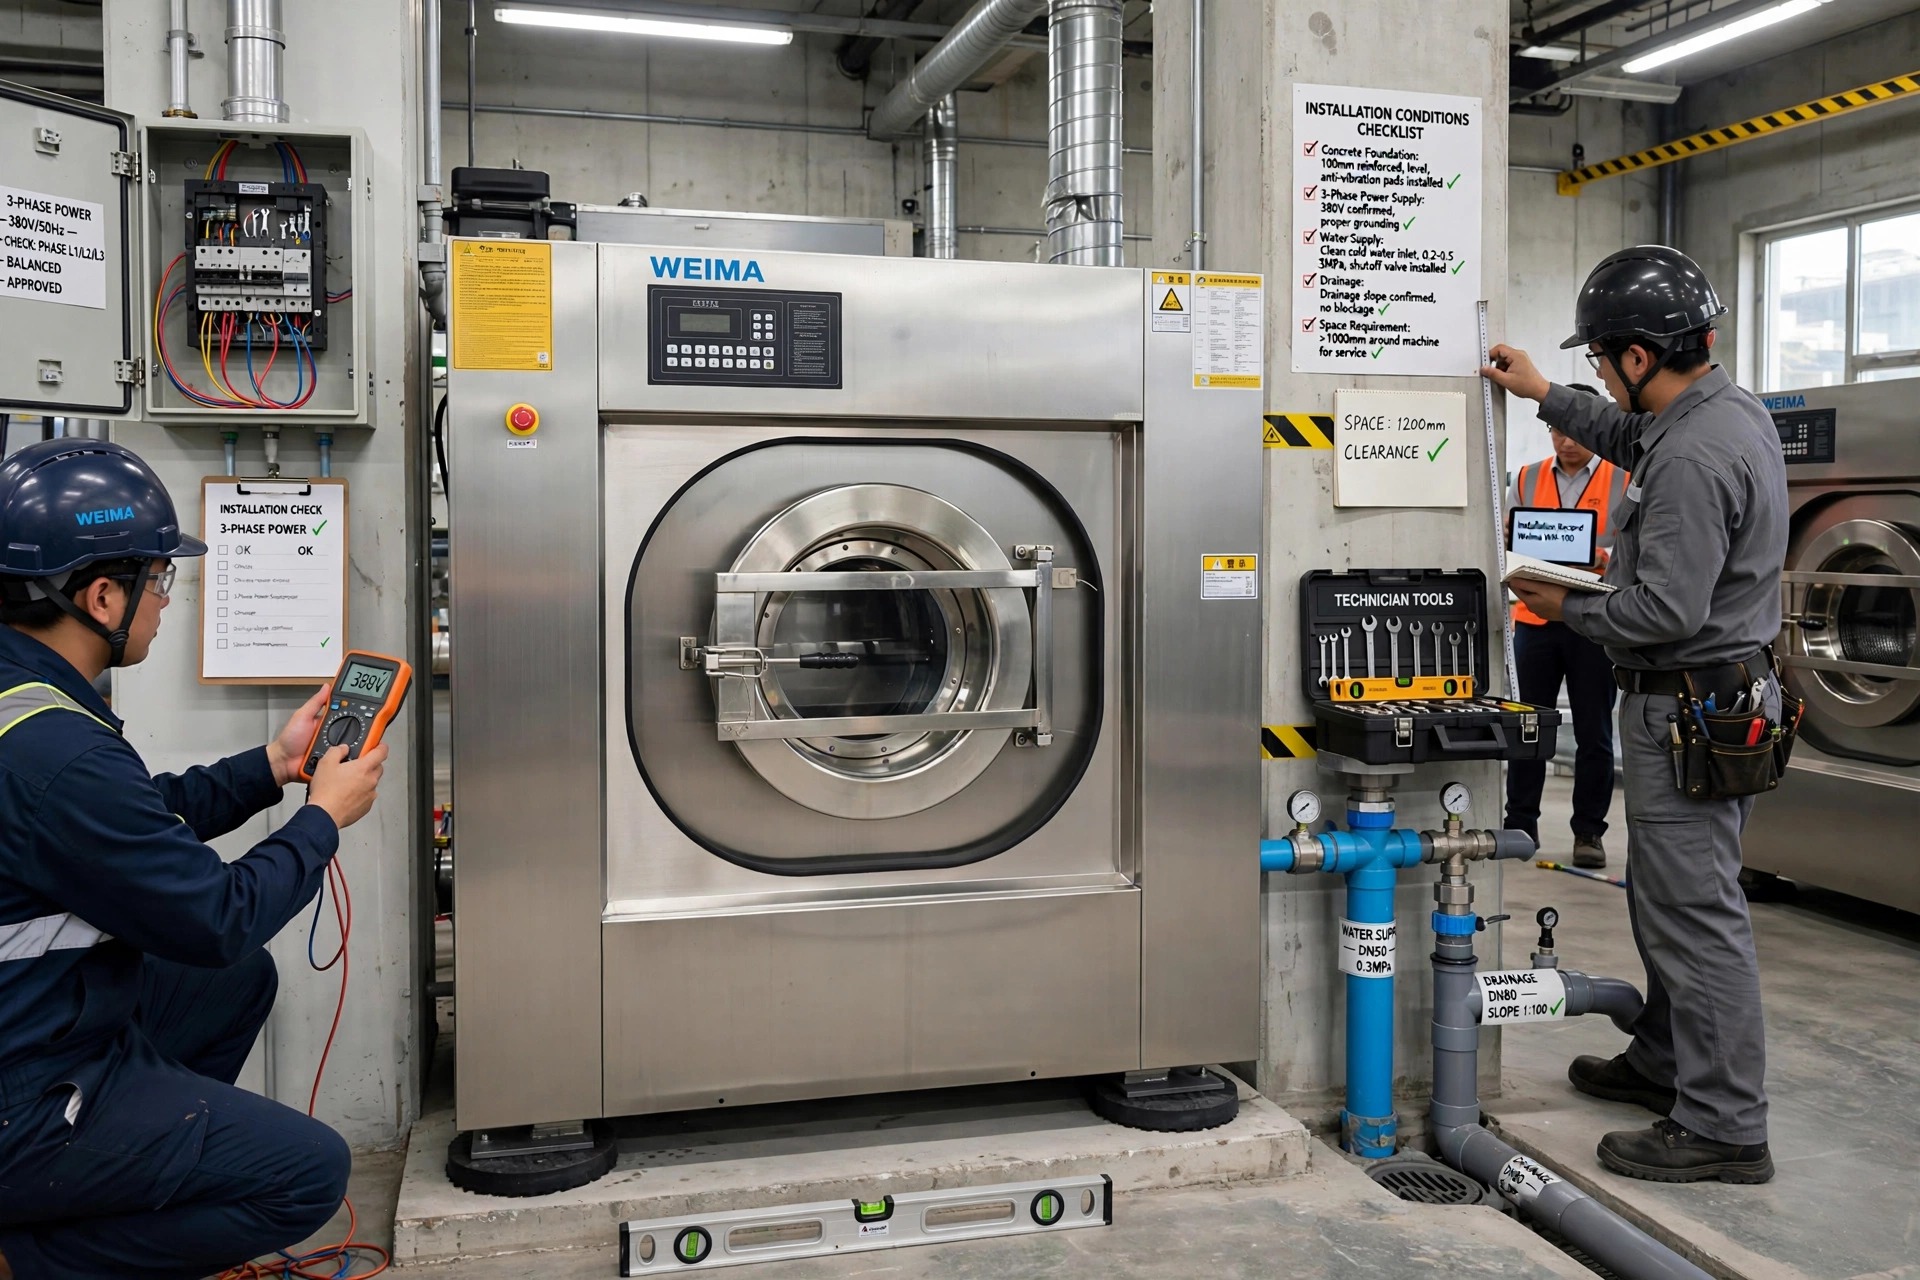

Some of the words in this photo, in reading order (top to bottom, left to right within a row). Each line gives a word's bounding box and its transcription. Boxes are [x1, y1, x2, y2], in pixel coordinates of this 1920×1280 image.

[1305, 101, 1392, 121] INSTALLATION
[1395, 108, 1470, 125] CONDITIONS
[1357, 123, 1424, 139] CHECKLIST
[1322, 144, 1362, 157] Concrete
[1364, 147, 1419, 160] Foundation:
[1321, 158, 1354, 170] 100mm
[1357, 160, 1405, 173] reinforced,
[1407, 162, 1430, 175] level,
[1321, 173, 1380, 184] anti-vibration
[1383, 175, 1404, 188] pads
[1406, 176, 1443, 188] installed
[1321, 189, 1357, 201] 3-Phase
[1360, 191, 1389, 202] Power
[1392, 193, 1424, 206] Supply:
[7, 195, 52, 213] 3-PHASE
[55, 204, 91, 221] POWER
[1321, 202, 1343, 214] 380V
[1347, 204, 1395, 217] confirmed,
[8, 215, 65, 236] 380V/50Hz
[1321, 217, 1351, 228] proper
[1354, 217, 1399, 231] grounding
[1320, 232, 1348, 243] Water
[1350, 233, 1384, 247] Supply:
[5, 236, 36, 250] CHECK:
[38, 240, 66, 255] PHASE
[69, 245, 104, 261] L1/L2/L3
[1320, 246, 1345, 256] Clean
[1349, 247, 1366, 257] cold
[1369, 250, 1394, 259] water
[1422, 250, 1454, 261] 0.2-0.5
[7, 256, 61, 274] BALANCED
[650, 256, 764, 282] WEIMA
[1350, 259, 1382, 271] shutoff
[1385, 260, 1407, 272] valve
[1410, 261, 1446, 273] installed
[7, 276, 62, 294] APPROVED
[1320, 275, 1364, 288] Drainage:
[1320, 289, 1360, 303] Drainage
[1364, 291, 1386, 302] slope
[1390, 292, 1436, 304] confirmed,
[1320, 303, 1331, 312] no
[1334, 303, 1374, 316] blockage
[1319, 320, 1347, 331] Space
[1350, 321, 1410, 334] Requirement:
[1369, 335, 1400, 345] around
[1403, 335, 1439, 346] machine
[1319, 346, 1332, 357] for
[1335, 348, 1367, 357] service
[1762, 395, 1805, 409] WEIMA
[1344, 414, 1391, 431] SPACE:
[1398, 417, 1446, 431] 1200mm
[1344, 444, 1419, 460] CLEARANCE
[75, 506, 134, 526] WEIMA
[220, 504, 287, 514] INSTALLATION
[290, 504, 322, 515] CHECK
[220, 524, 265, 534] 3-PHASE
[268, 524, 307, 535] POWER
[235, 545, 251, 555] OK
[298, 546, 313, 556] OK
[1334, 593, 1409, 606] TECHNICIAN
[1412, 593, 1454, 606] TOOLS
[1342, 923, 1373, 940] WATER
[1358, 945, 1387, 957] DN50
[1357, 960, 1391, 973] 0.3MPa
[1483, 974, 1538, 986] DRAINAGE
[1488, 989, 1517, 1001] DN80
[1488, 1006, 1519, 1018] SLOPE
[1524, 1004, 1547, 1015] 1:100
